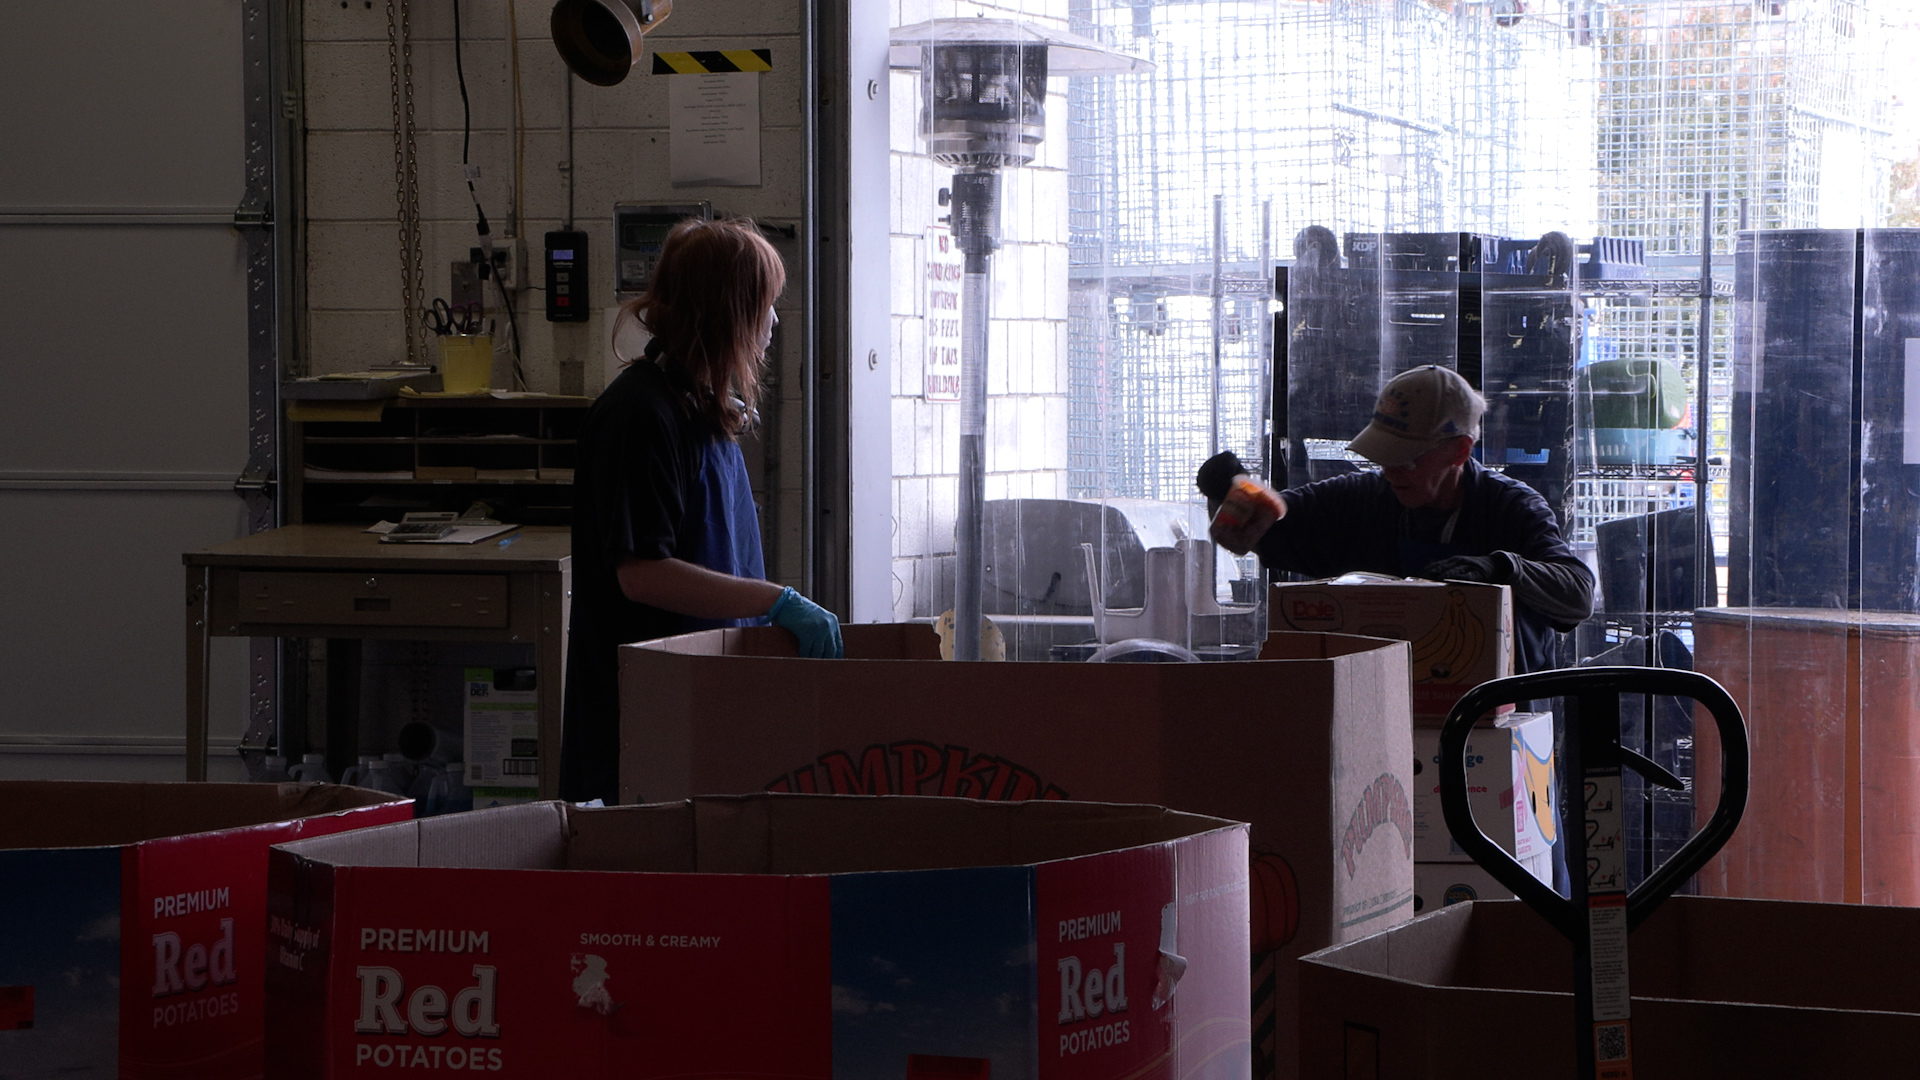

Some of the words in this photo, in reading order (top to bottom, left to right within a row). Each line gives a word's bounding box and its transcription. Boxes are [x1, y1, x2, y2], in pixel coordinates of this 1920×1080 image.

[927, 374, 960, 394] BUILDING
[1291, 599, 1335, 617] Dole
[154, 887, 230, 919] PREMIUM
[360, 927, 489, 954] PREMIUM
[580, 933, 642, 946] SMOOTH
[646, 935, 655, 946] &
[659, 935, 721, 948] CREAMY
[1058, 910, 1122, 944] PREMIUM
[152, 917, 237, 998] Red
[299, 952, 306, 971] C
[1056, 942, 1129, 1026] Red
[152, 992, 238, 1029] POTATOES
[353, 964, 500, 1037] Red
[1058, 1019, 1131, 1057] POTATOES
[356, 1043, 503, 1071] POTATOES
